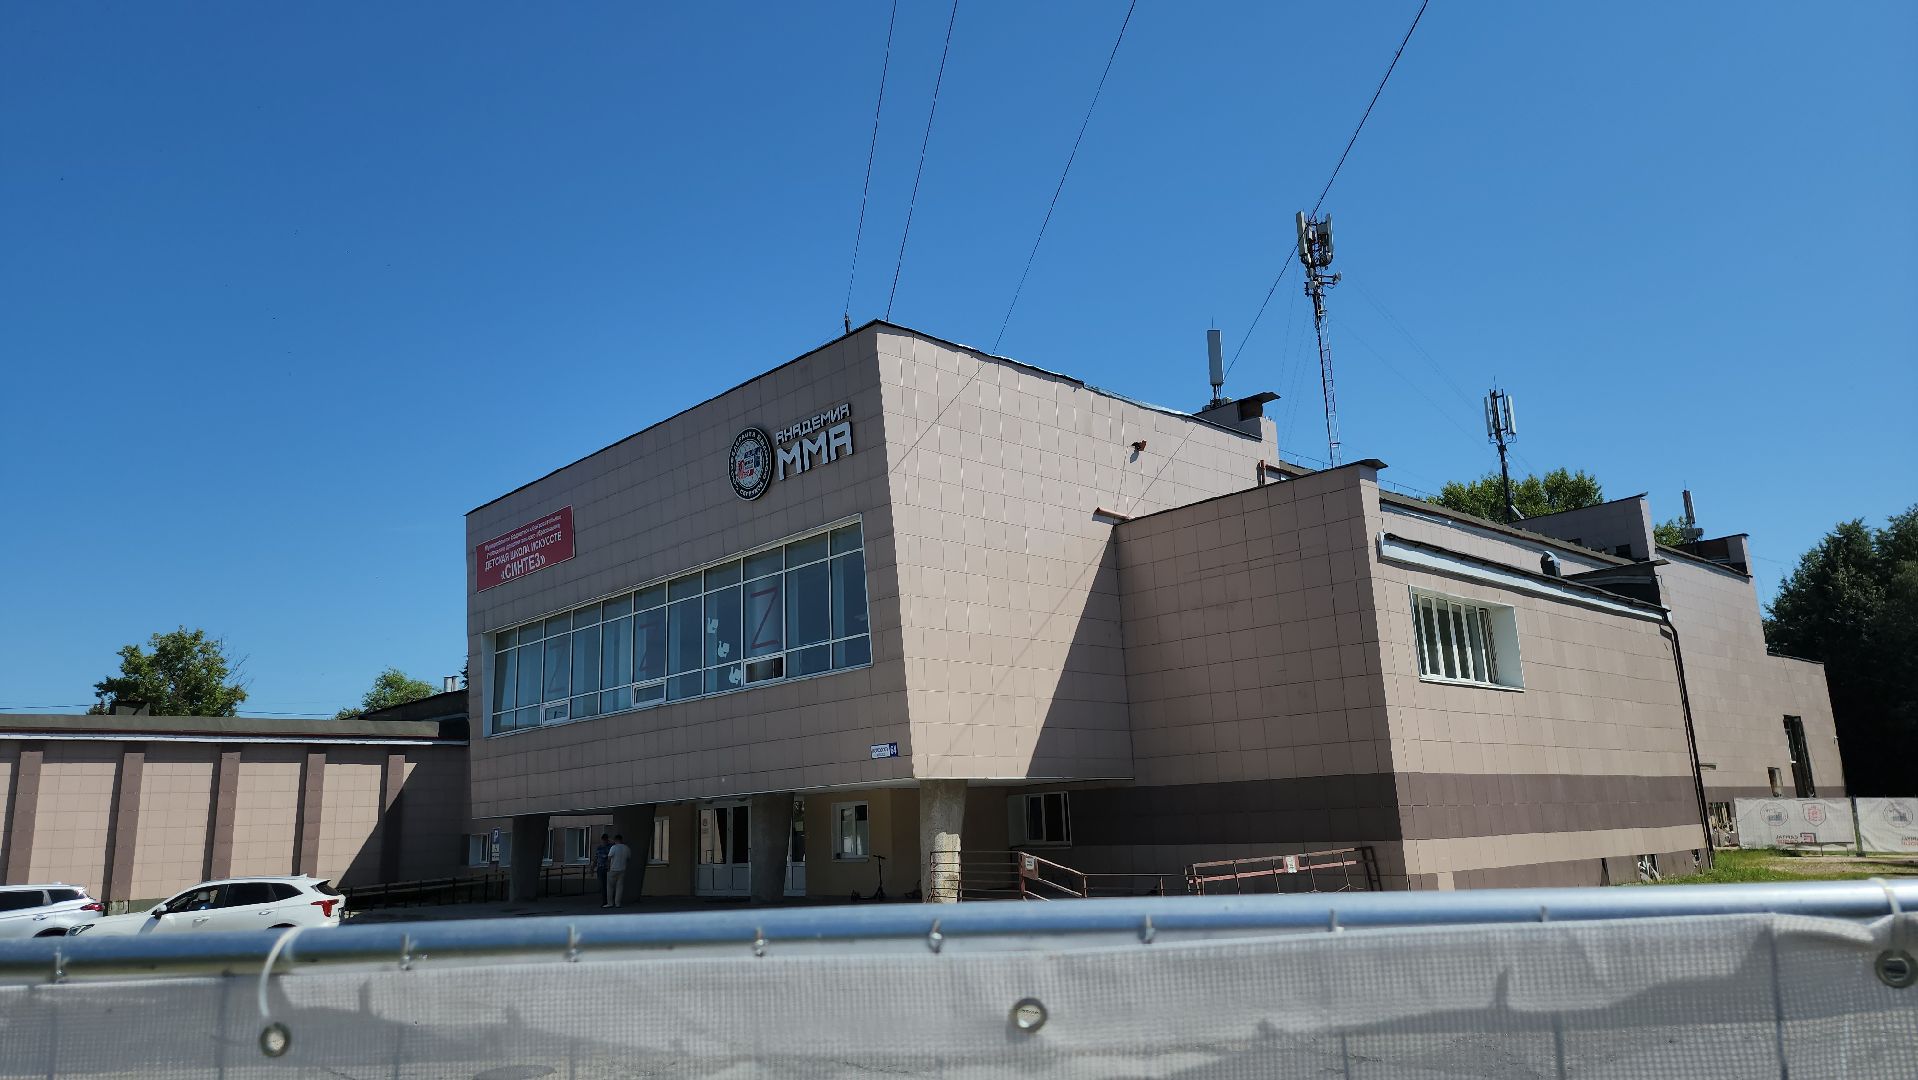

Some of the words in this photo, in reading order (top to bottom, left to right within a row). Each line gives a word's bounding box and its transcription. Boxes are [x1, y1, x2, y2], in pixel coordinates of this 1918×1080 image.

[776, 421, 853, 481] ММА
[484, 552, 510, 572] ДЕТСКАЯ
[510, 544, 530, 561] ШКОЛА
[500, 552, 546, 580] «СИНТЕЗ»
